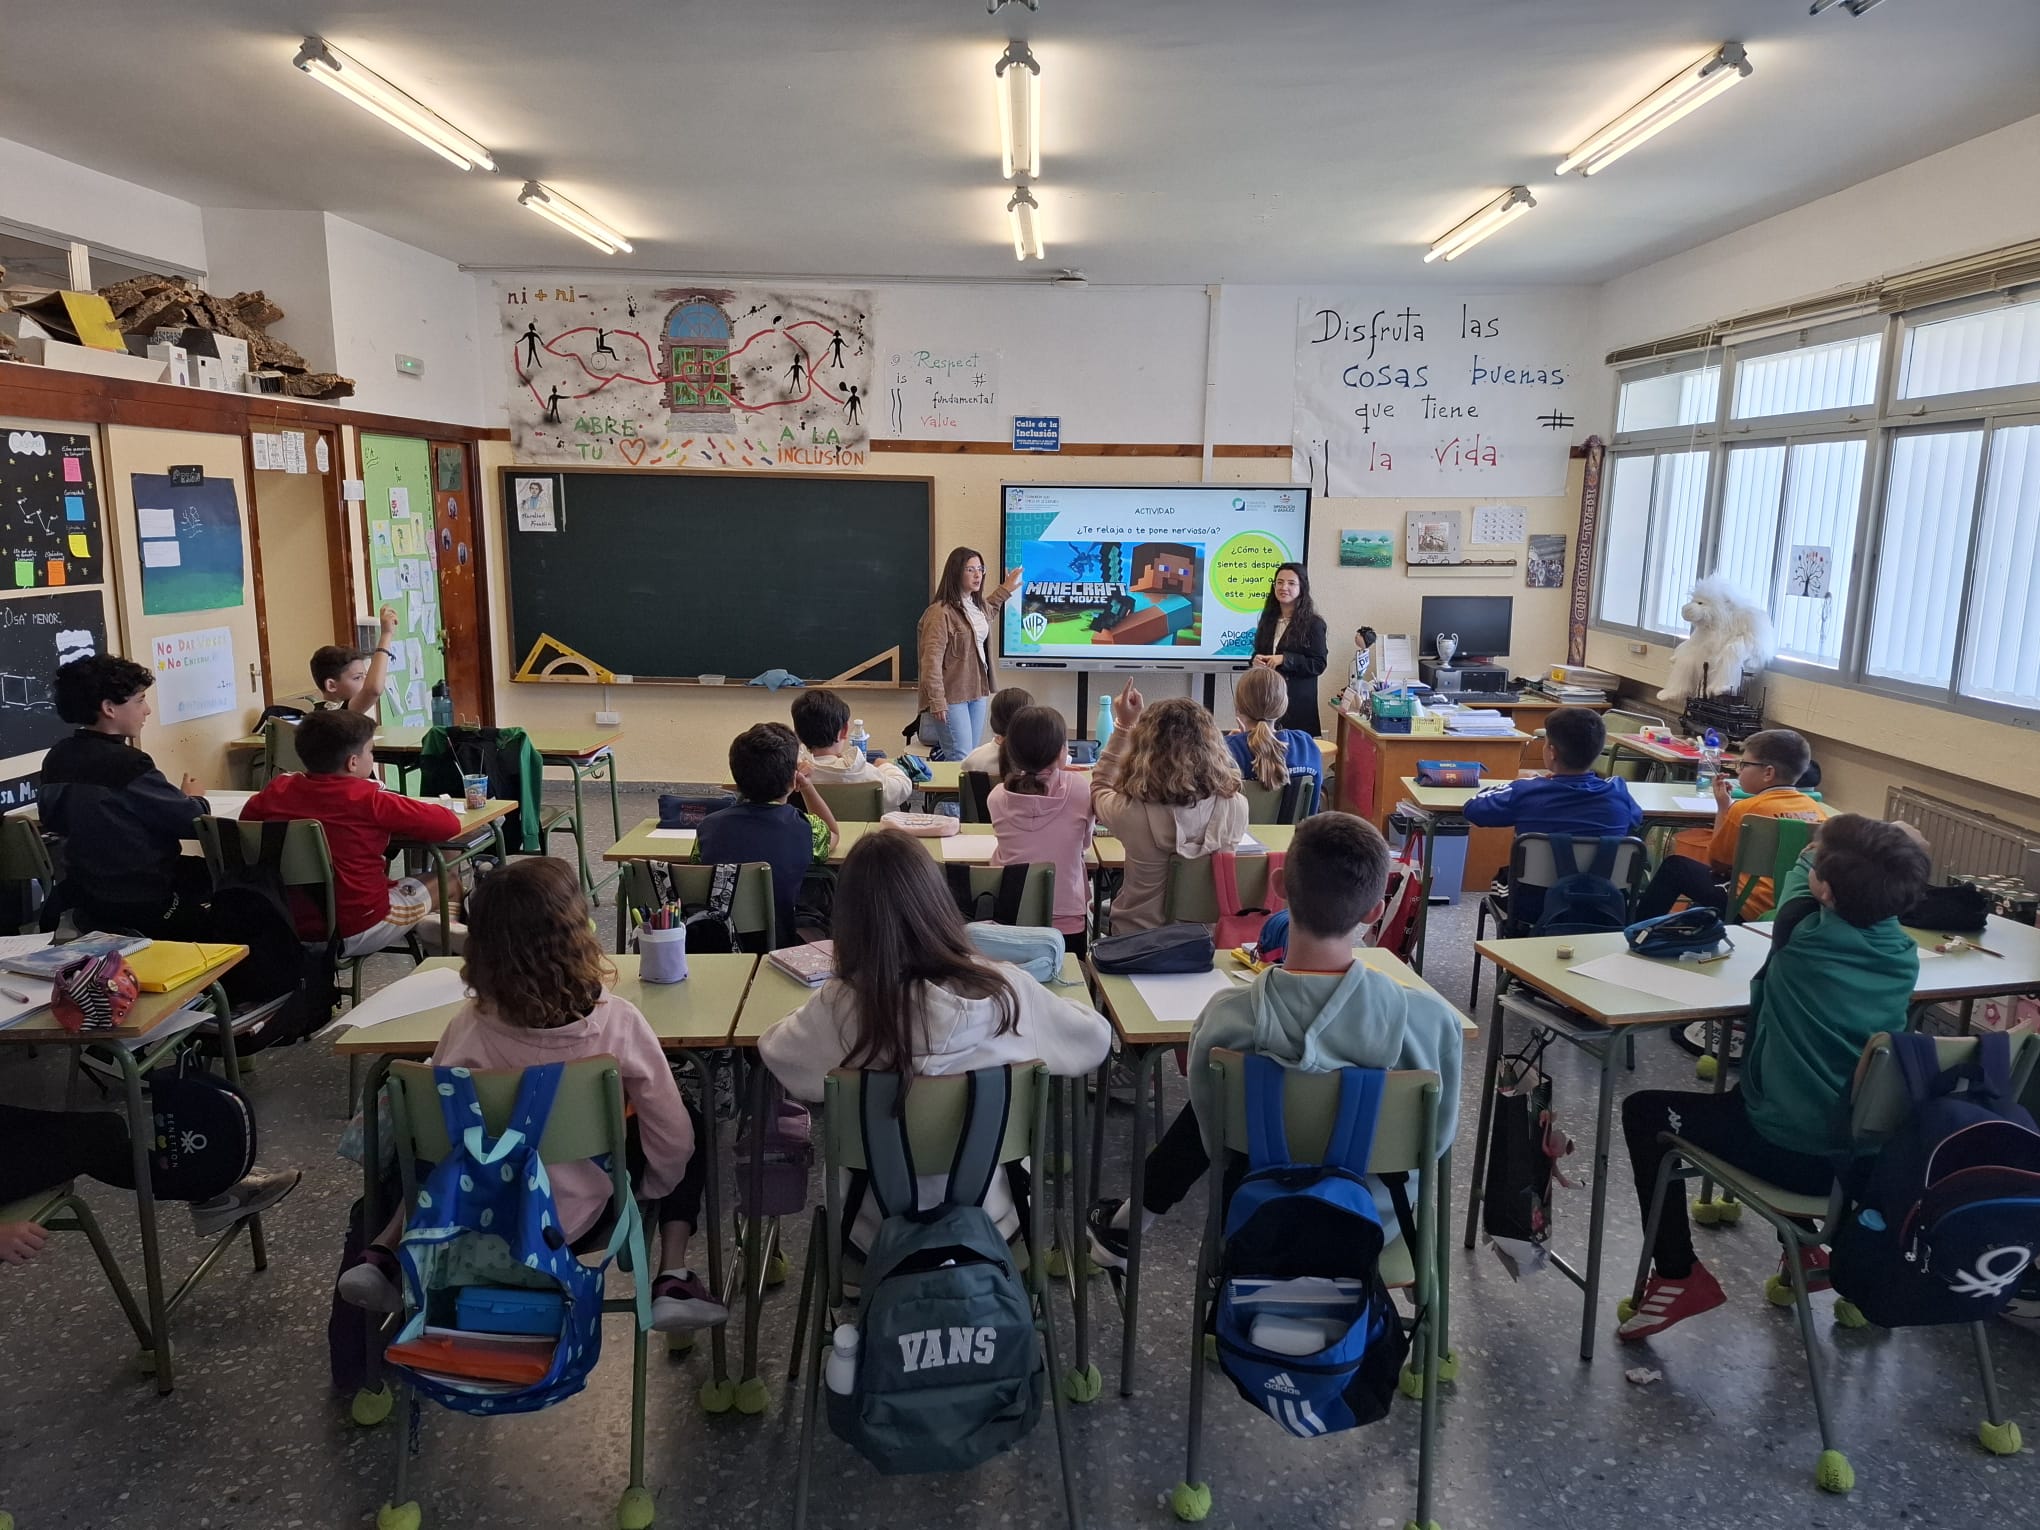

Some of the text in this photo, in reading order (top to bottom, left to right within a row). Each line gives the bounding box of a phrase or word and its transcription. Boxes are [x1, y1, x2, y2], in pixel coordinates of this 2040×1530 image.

[508, 287, 528, 305] ni
[555, 285, 576, 303] ni
[1311, 303, 1500, 360] Disfruta las
[914, 350, 979, 377] Respect
[1471, 355, 1565, 386] buenas
[897, 372, 933, 385] is a
[932, 391, 994, 408] fundamental
[1355, 394, 1479, 434] que tiene
[573, 416, 638, 438] ABRE
[1016, 420, 1058, 428] Calle de la
[812, 426, 841, 445] LA
[1016, 429, 1057, 438] Inclusión
[576, 443, 604, 461] TU
[1369, 441, 1392, 471] la
[1134, 506, 1175, 515] ACTIVIDAD
[1077, 525, 1093, 535] ¿Te
[1097, 525, 1124, 536] relaja
[1136, 526, 1146, 535] te
[1148, 527, 1169, 538] pone
[1172, 526, 1221, 536] nervioso/a?
[1231, 546, 1273, 555] ¿Cómo te
[1217, 560, 1282, 571] sientes despué
[1227, 575, 1238, 583] de
[1241, 576, 1264, 585] jugar
[1025, 581, 1128, 597] MINECRAFT
[1043, 595, 1108, 604] THE MOVIE
[32, 613, 61, 625] MENOR
[1221, 630, 1256, 639] ADICCIO
[157, 642, 172, 655] No
[167, 658, 182, 669] No
[0, 790, 15, 804] SA
[166, 1113, 179, 1169] BENETTON
[898, 1326, 997, 1373] VANS
[1264, 1381, 1301, 1396] adidas
